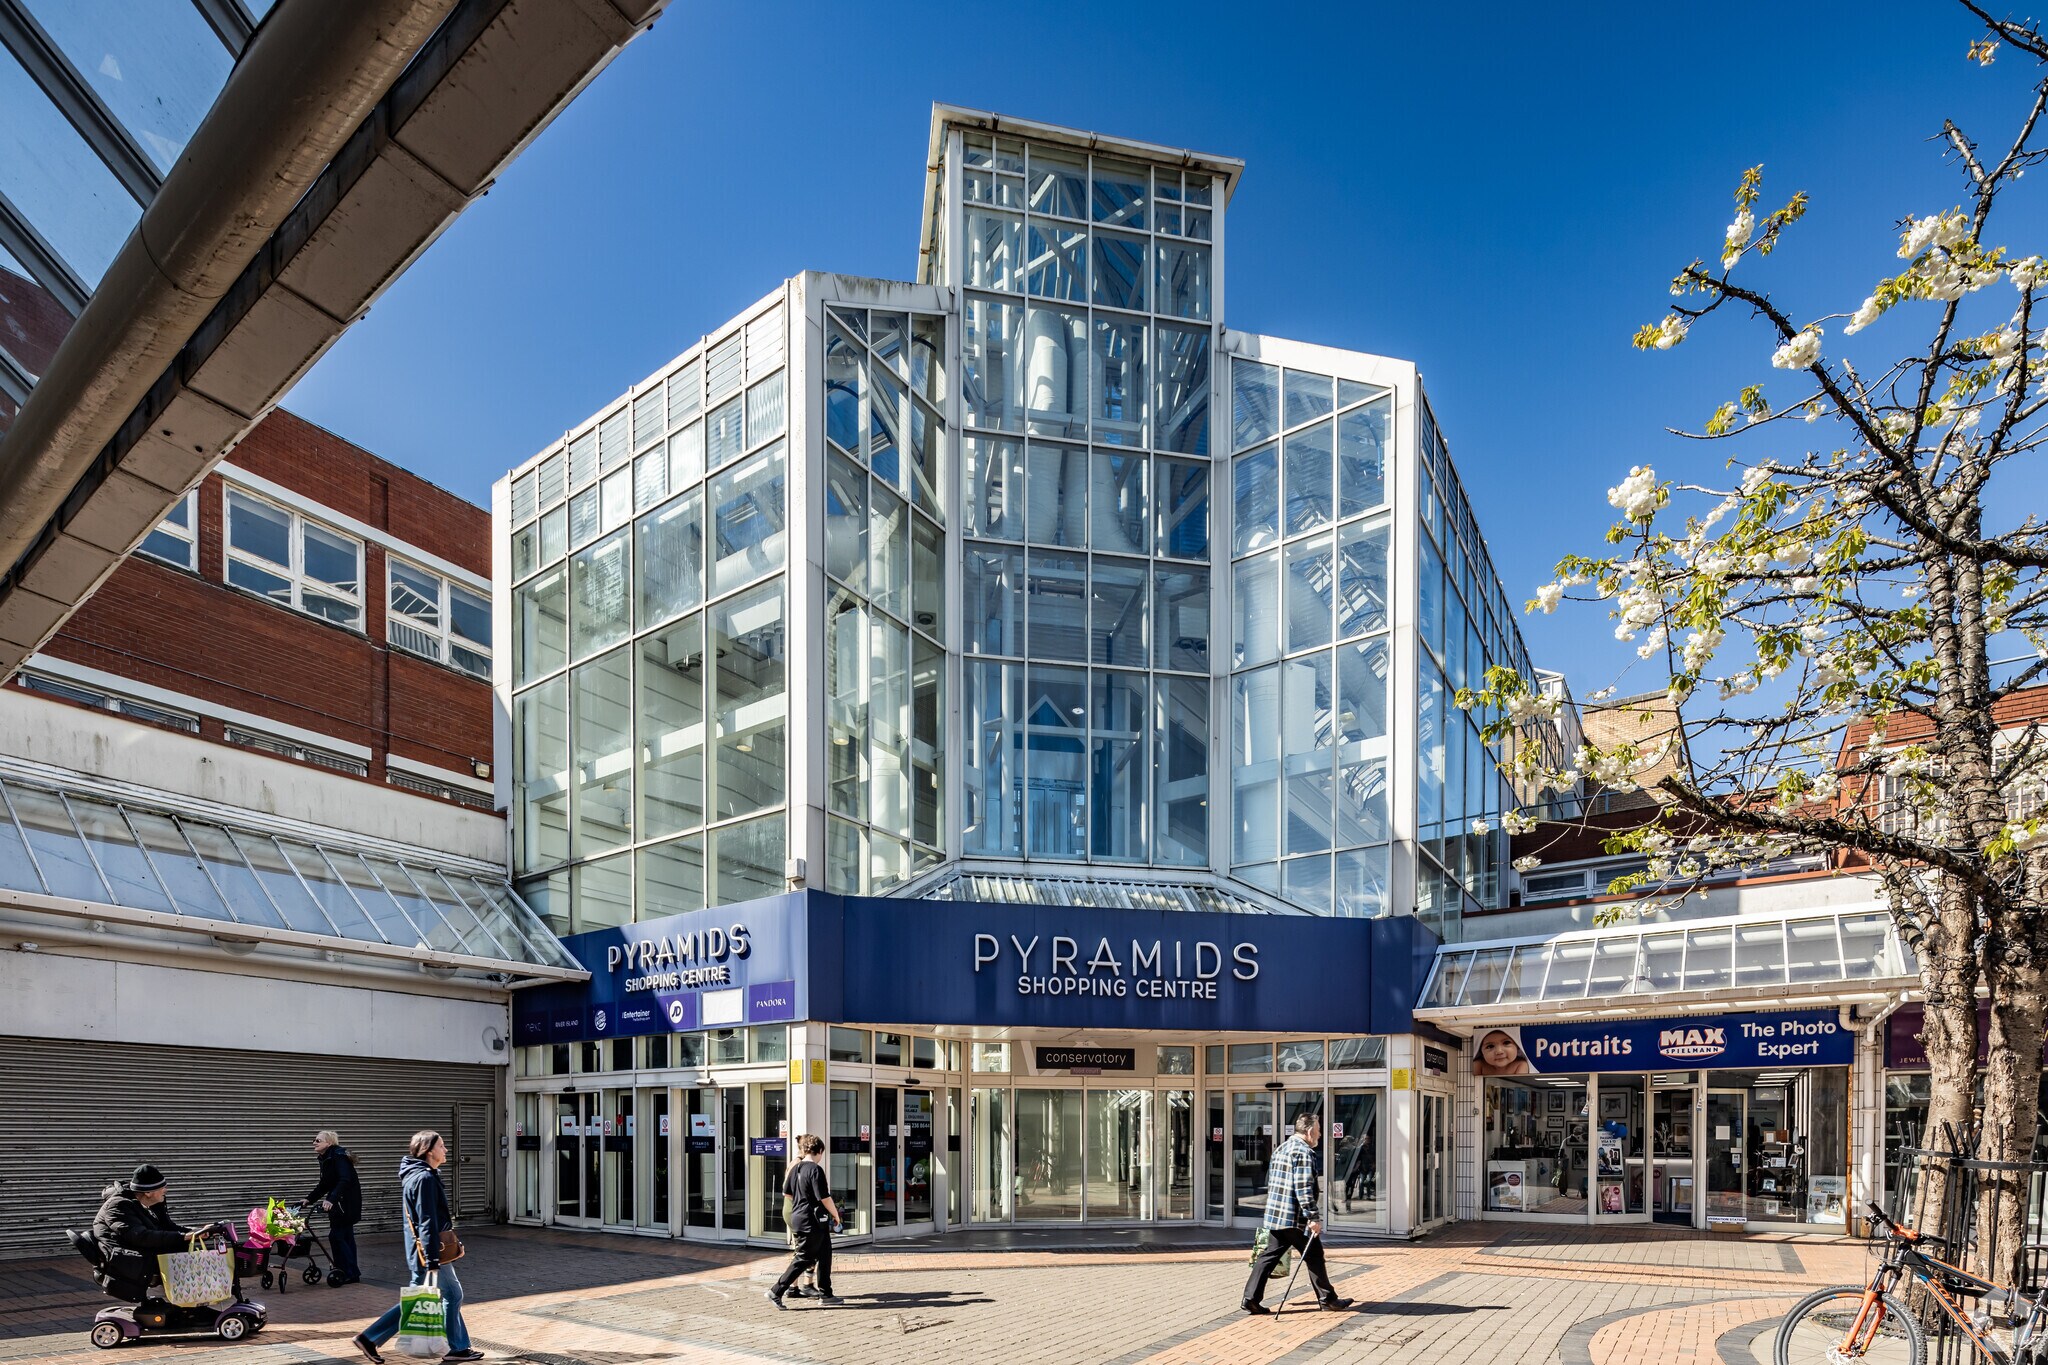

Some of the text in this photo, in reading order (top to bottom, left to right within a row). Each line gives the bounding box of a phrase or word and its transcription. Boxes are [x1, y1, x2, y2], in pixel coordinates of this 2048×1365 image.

[608, 923, 748, 973] PYRAMIDS
[974, 933, 1260, 981] PYRAMIDS
[625, 965, 727, 993] SHOPPING CENTRE
[1018, 976, 1217, 999] SHOPPING CENTRE
[756, 998, 787, 1009] PANDORA
[566, 1019, 579, 1027] ISLAND
[623, 1009, 651, 1019] Entertainer
[1659, 1027, 1726, 1047] MAX
[1740, 1020, 1837, 1037] The Photo
[1535, 1035, 1633, 1058] Portraits
[1665, 1046, 1720, 1055] SPIELMANN
[1758, 1040, 1820, 1059] Expert
[1045, 1052, 1127, 1066] conservatory
[411, 1301, 443, 1315] ASDA
